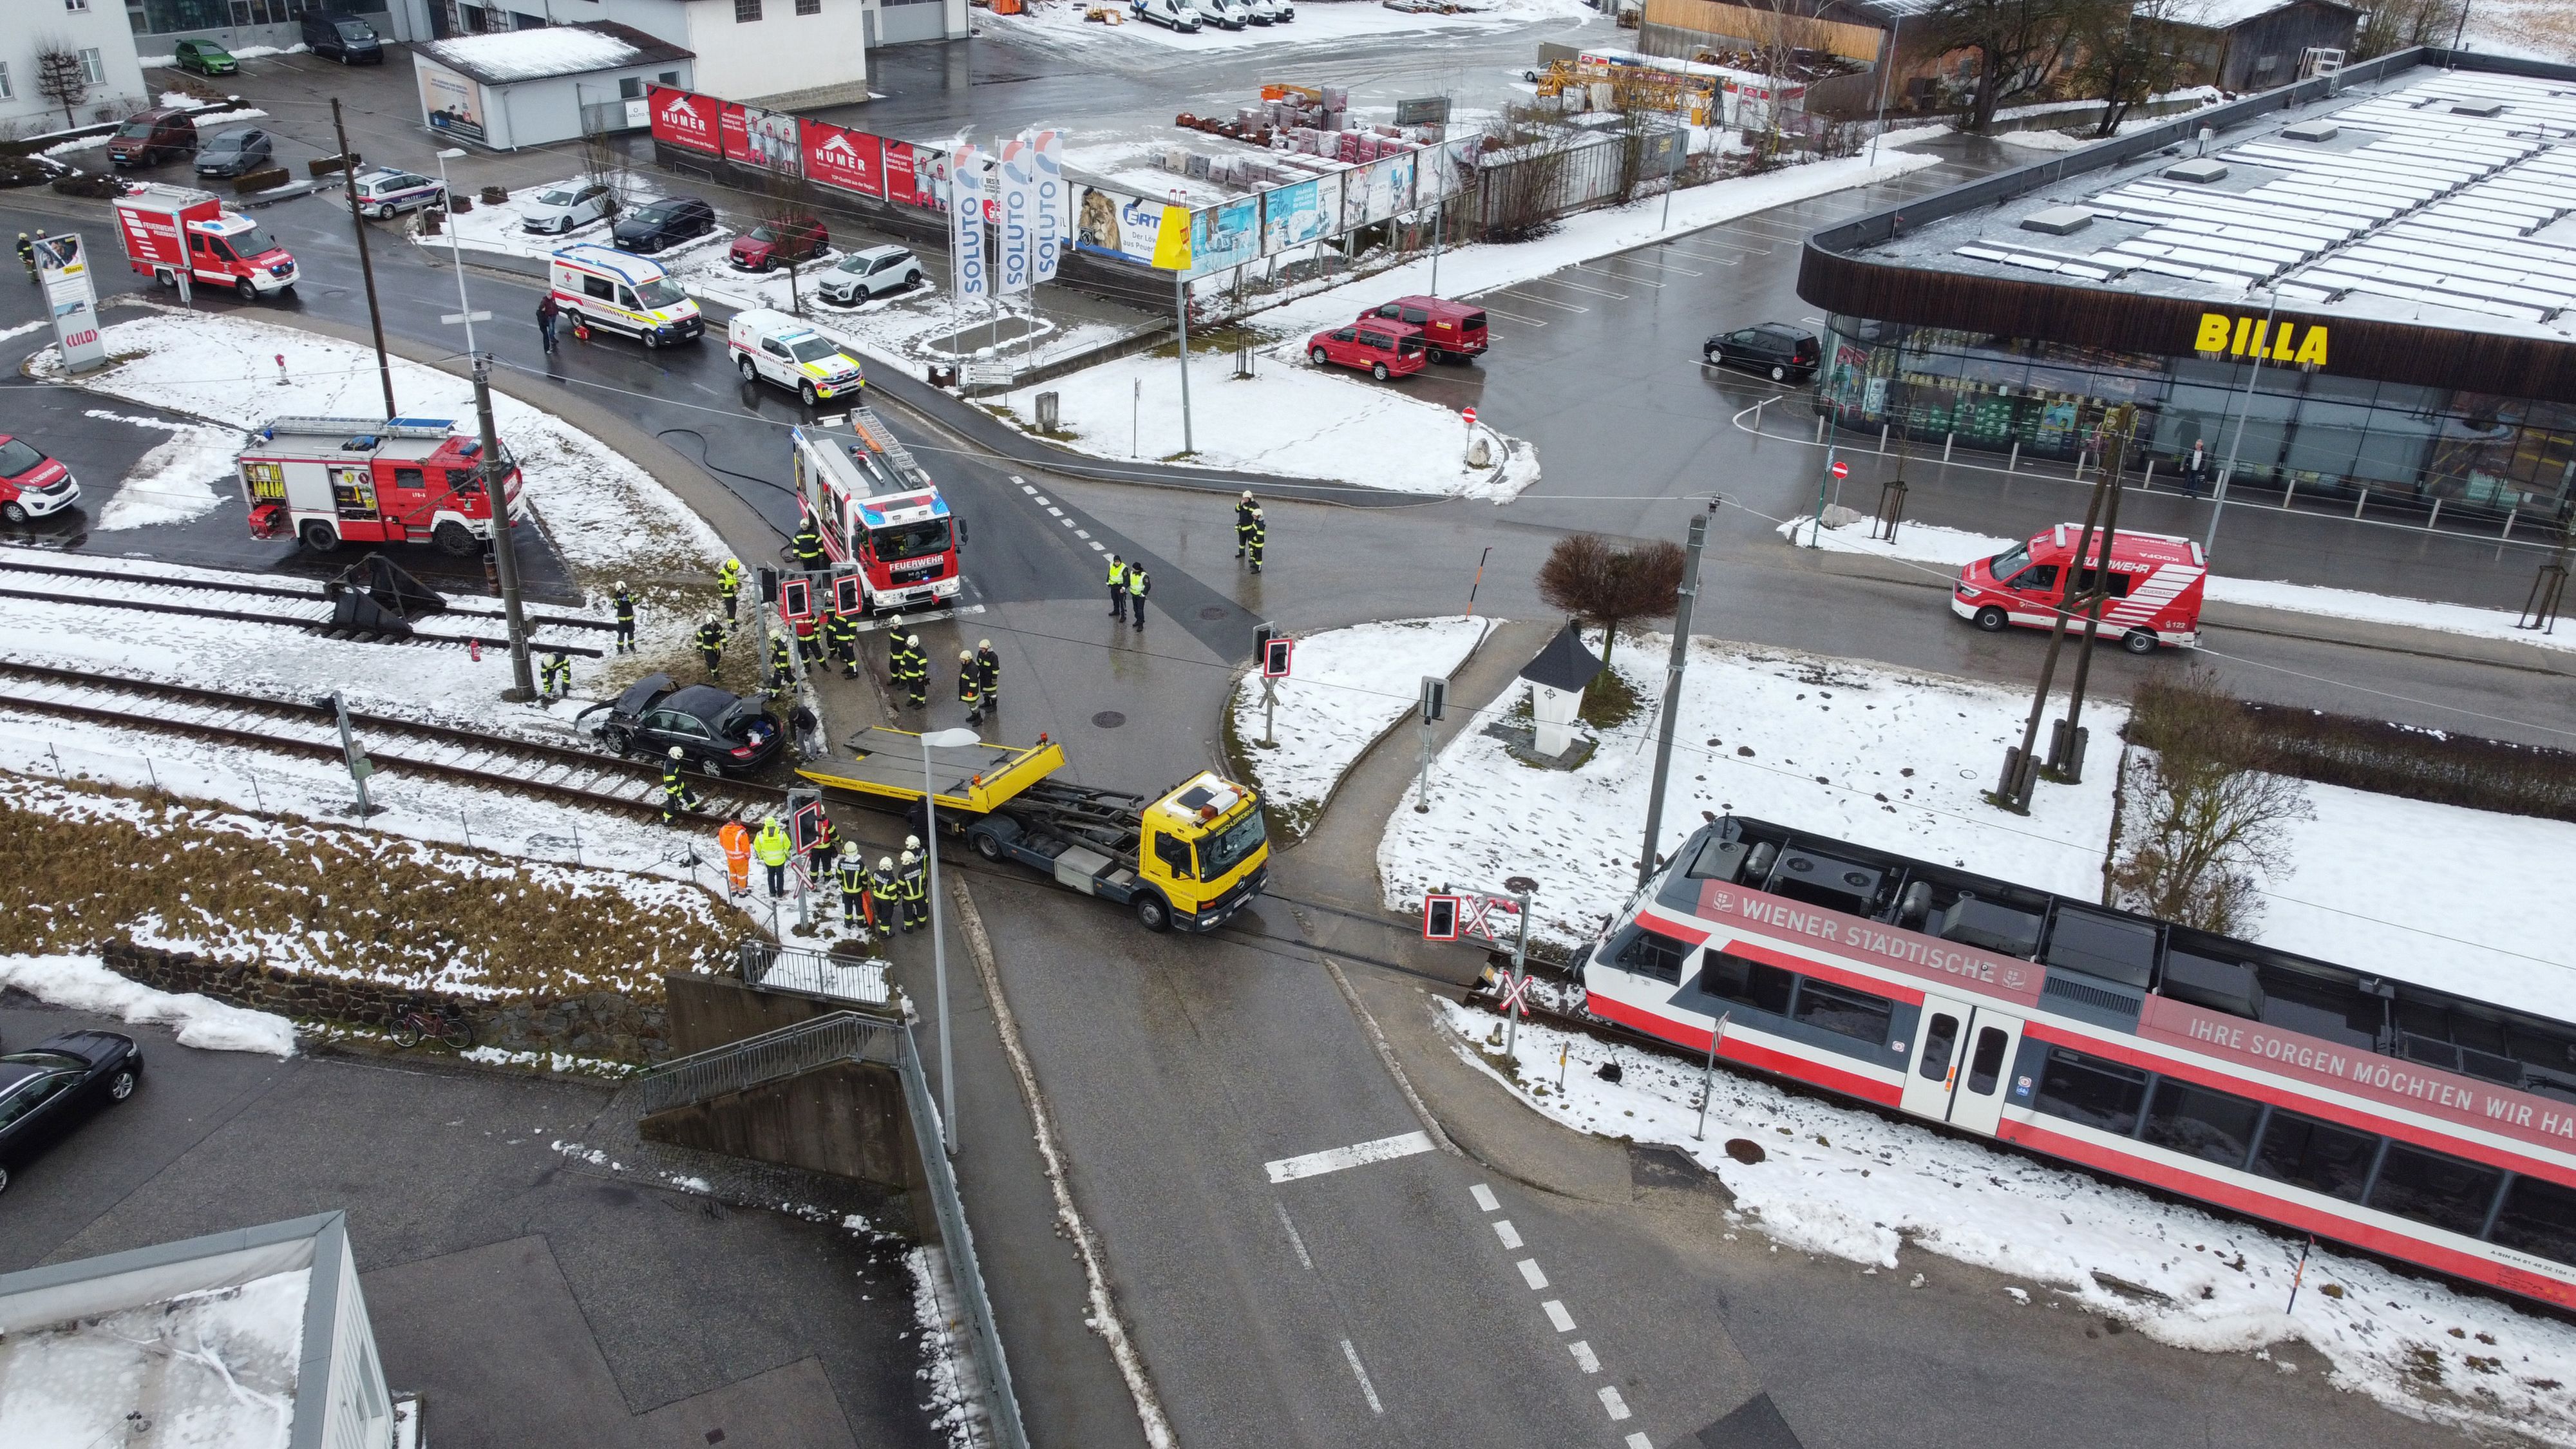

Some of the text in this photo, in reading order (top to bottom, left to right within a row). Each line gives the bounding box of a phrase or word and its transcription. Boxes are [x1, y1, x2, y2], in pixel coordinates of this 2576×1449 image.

[661, 110, 706, 131] HUMER
[815, 148, 866, 171] HUMER
[142, 222, 176, 233] FEUERWEHR
[1039, 181, 1057, 273] SOLUTO
[1126, 210, 1161, 229] ERT
[960, 197, 982, 294] SOLUTO
[1006, 191, 1025, 285] SOLUTO
[1132, 231, 1157, 243] Der Löw
[1136, 241, 1155, 252] Peuer
[260, 253, 290, 265] FEUERWEHR
[65, 265, 82, 274] Stern
[2194, 313, 2327, 365] BILLA
[29, 465, 61, 484] FEUERWEHR
[895, 516, 927, 525] PEUERBACH
[2132, 536, 2183, 547] PEUERBACH
[889, 554, 944, 571] FEUERWEHR
[2070, 555, 2151, 574] UERWEHR
[2139, 551, 2179, 562] KDOFA
[2140, 589, 2174, 597] PEUERBACH
[1215, 806, 1256, 837] ABSCHLEPPDIENST
[1743, 897, 1997, 983] WIENER STÄDTISCHE
[2189, 1018, 2244, 1050] IHRE
[2249, 1035, 2346, 1077] SORGEN
[2353, 1061, 2473, 1111] MÖCHTEN
[2486, 1096, 2533, 1127] WIR
